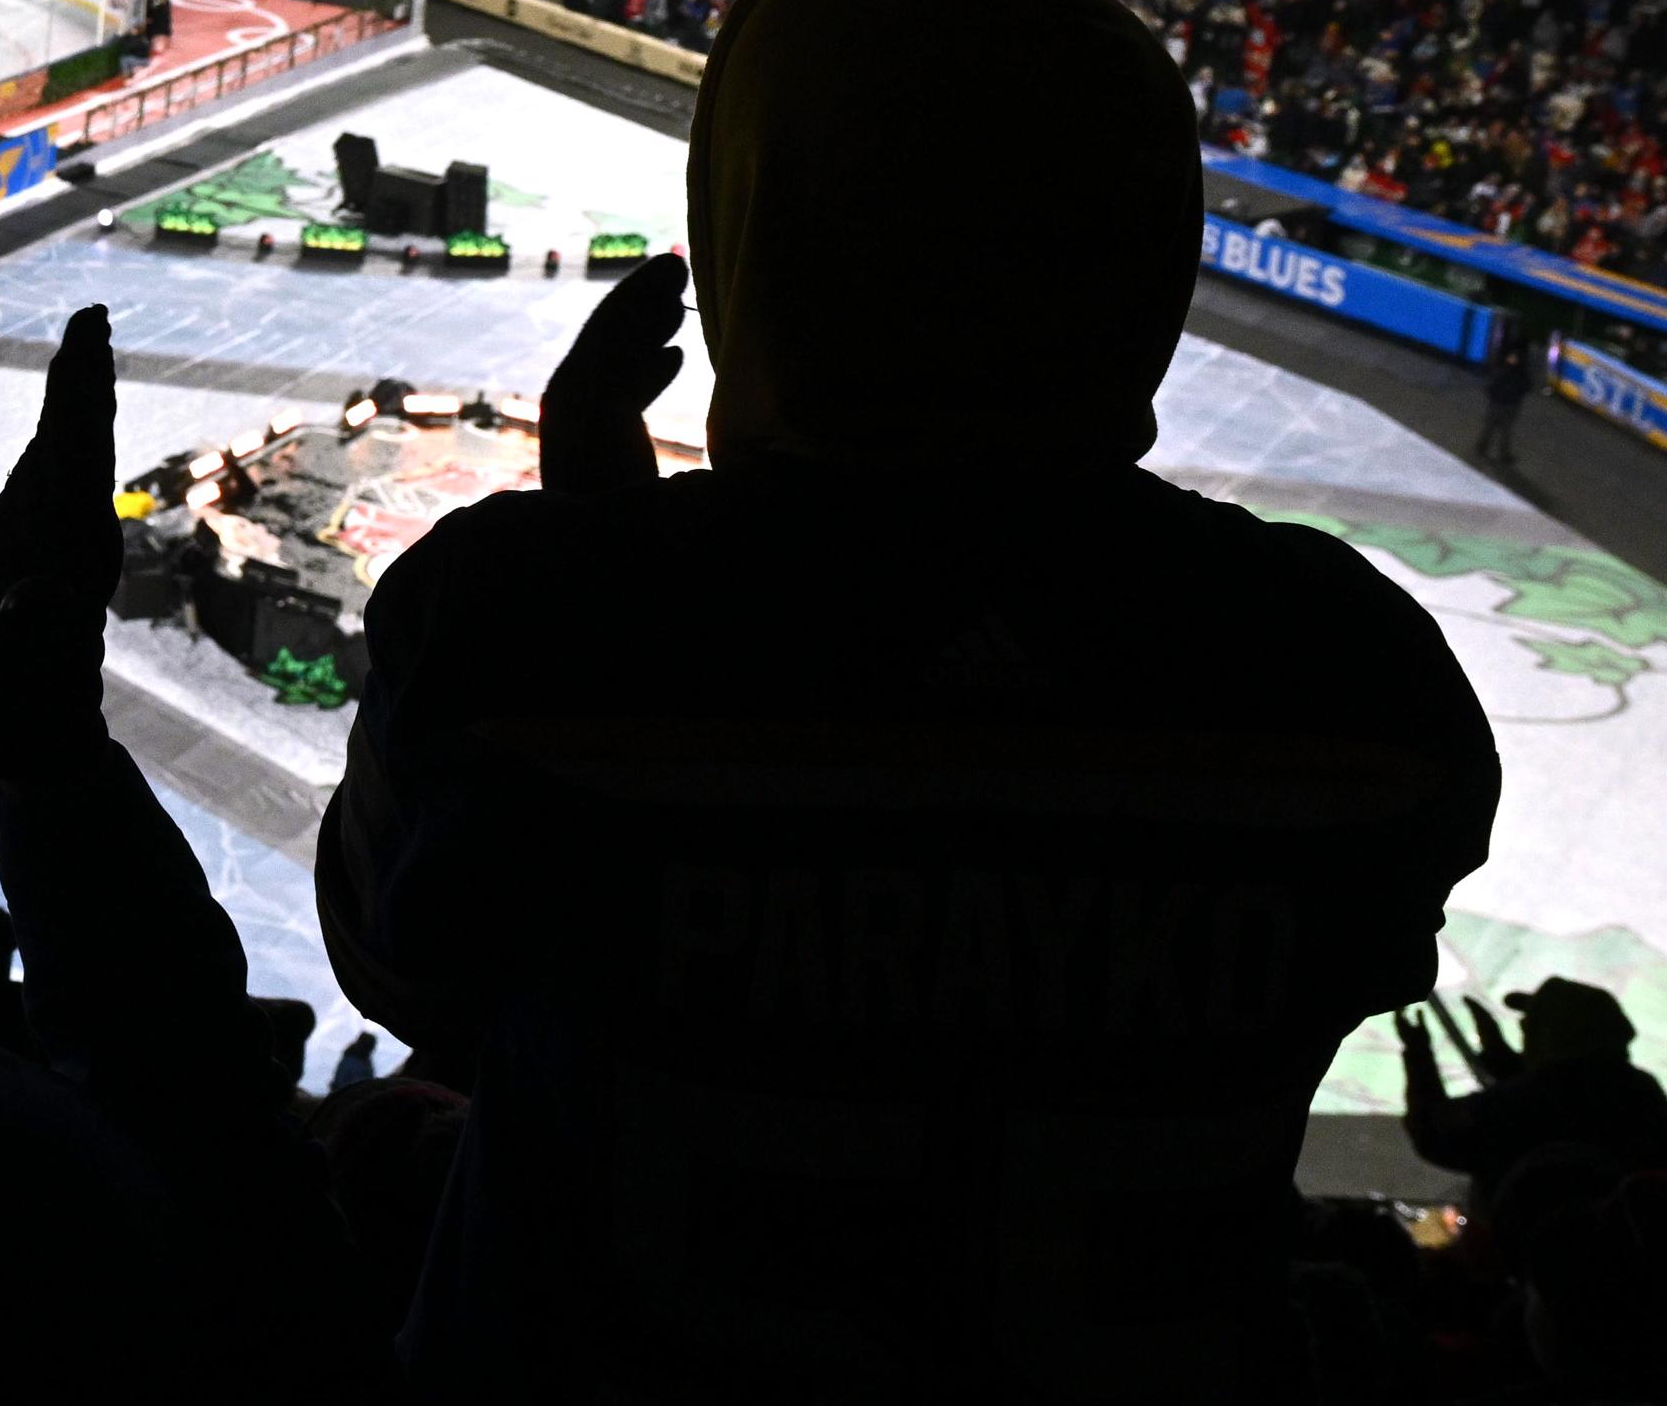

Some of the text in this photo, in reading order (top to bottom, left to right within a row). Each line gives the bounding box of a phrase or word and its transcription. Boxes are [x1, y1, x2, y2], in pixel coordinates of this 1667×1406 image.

[1220, 229, 1346, 308] BLUES
[1582, 365, 1650, 431] STL
[658, 860, 1297, 1036] PARAYKO
